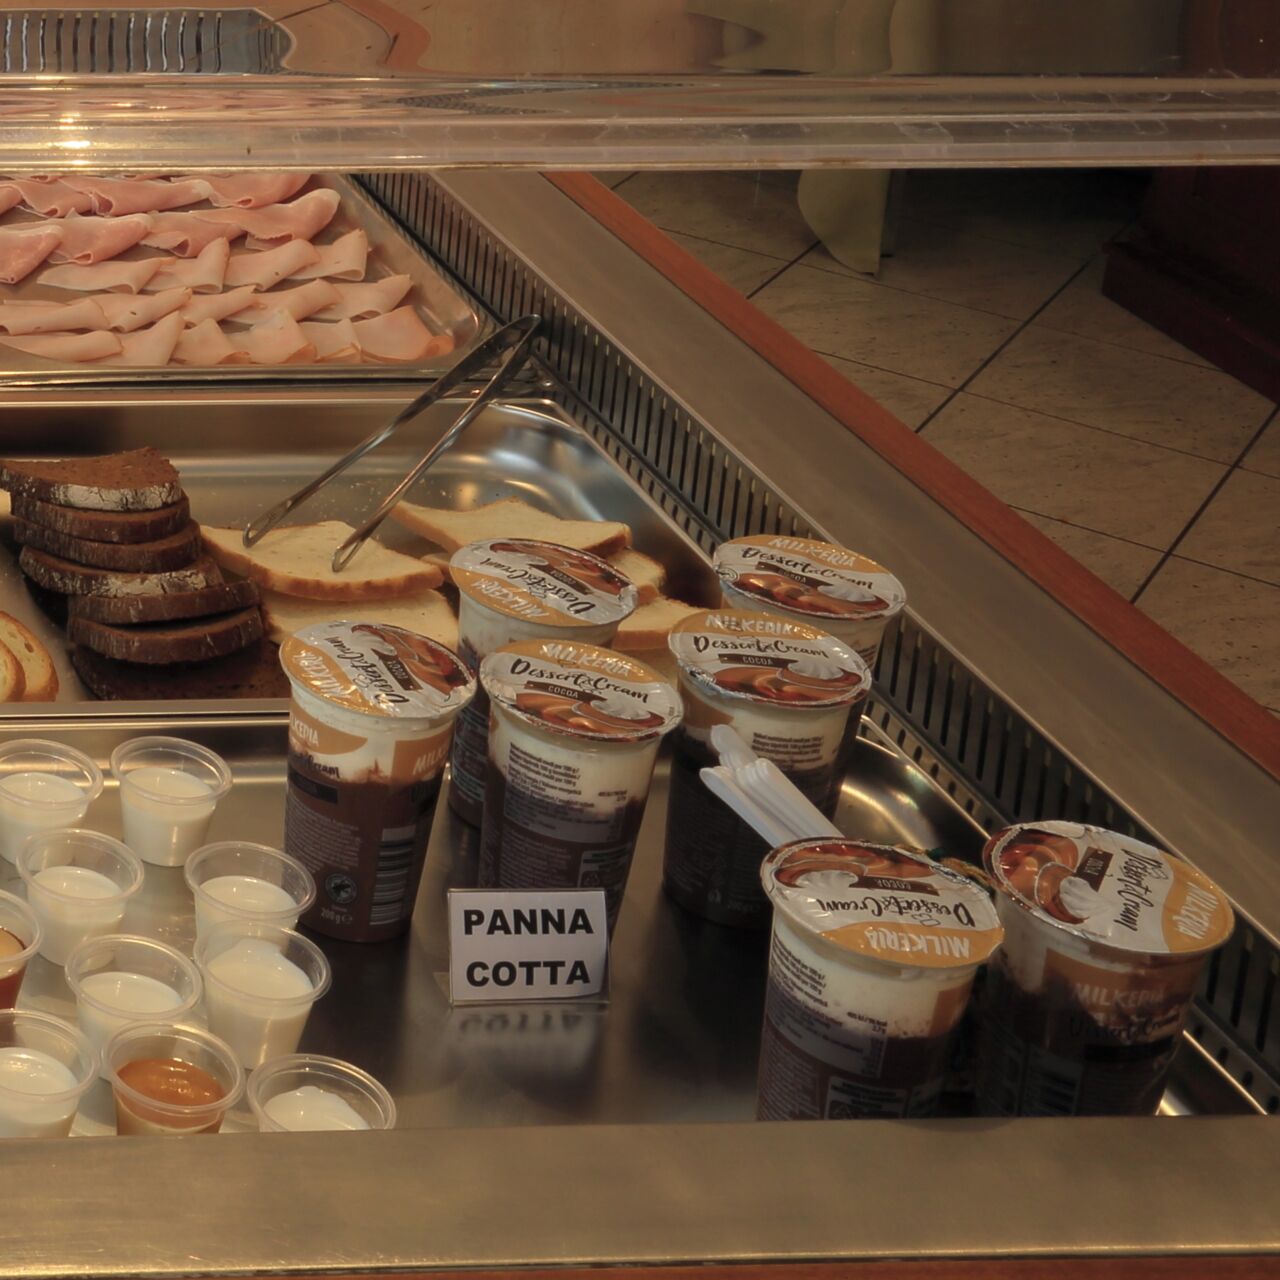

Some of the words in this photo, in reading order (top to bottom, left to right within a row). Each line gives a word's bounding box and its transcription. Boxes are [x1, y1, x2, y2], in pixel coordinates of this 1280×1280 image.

[742, 656, 774, 666] COCOA
[548, 684, 579, 699] COCOA
[464, 908, 594, 935] PANNA
[864, 926, 971, 959] MILKERIA
[466, 960, 591, 987] COTTA
